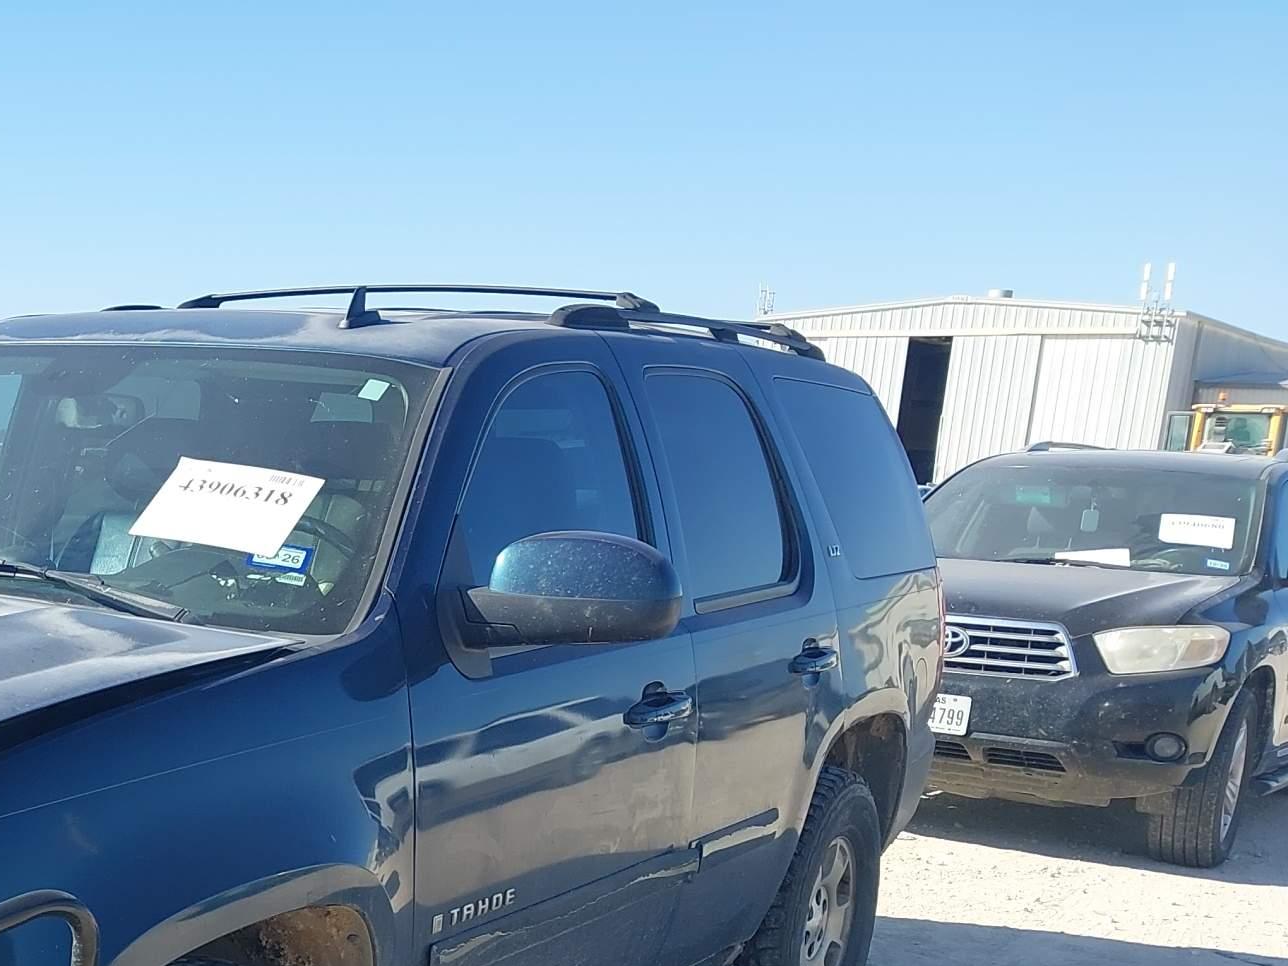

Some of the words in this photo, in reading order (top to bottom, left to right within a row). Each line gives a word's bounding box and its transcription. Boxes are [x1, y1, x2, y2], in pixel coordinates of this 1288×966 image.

[179, 477, 293, 506] 43906318
[281, 553, 301, 565] 26
[450, 888, 516, 926] TAHOE
